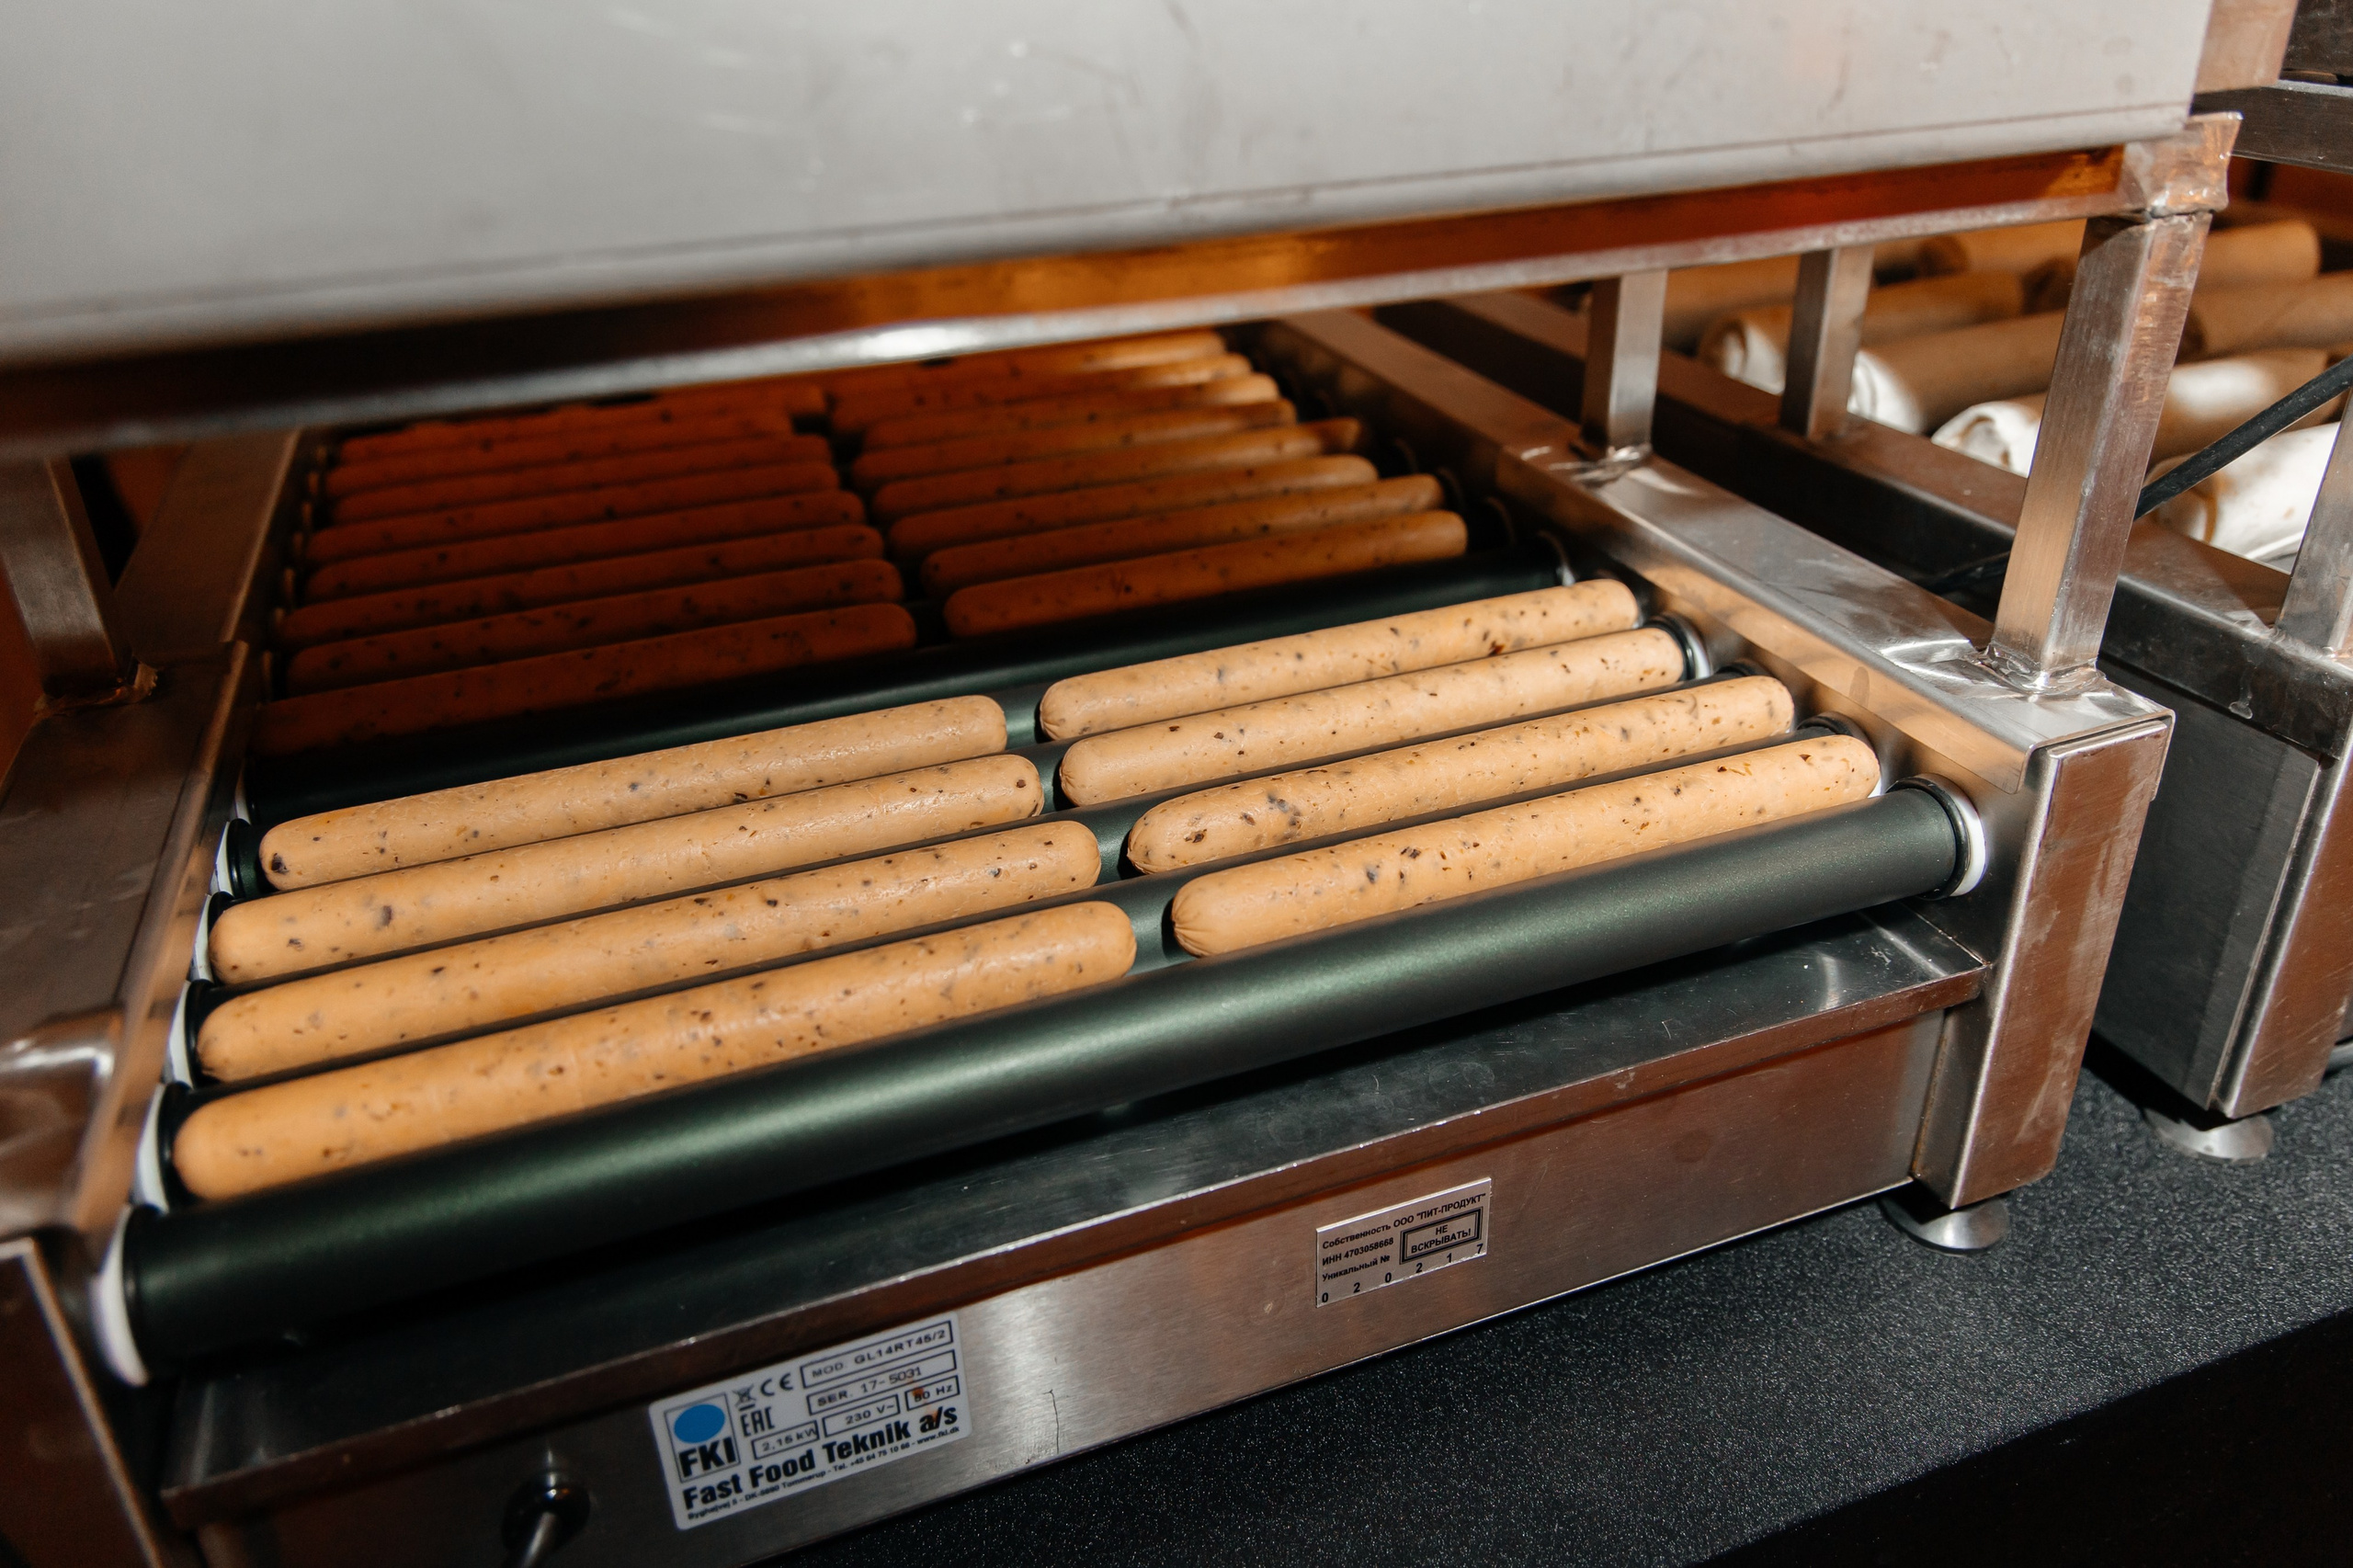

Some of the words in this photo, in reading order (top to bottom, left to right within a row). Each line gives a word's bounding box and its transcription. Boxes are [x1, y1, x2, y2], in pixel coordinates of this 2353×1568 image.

[1322, 1223, 1392, 1250] Собственность
[1393, 1214, 1415, 1228] ООО
[1416, 1193, 1486, 1220] "ПИТ-ПРОДУКТ"
[1435, 1224, 1449, 1235] НЕ
[1322, 1253, 1342, 1267] ИНН
[1344, 1237, 1394, 1258] 4703058668
[1411, 1228, 1472, 1254] ВСКРЫВАТЬ!
[1322, 1257, 1379, 1281] Уникальный
[1380, 1255, 1391, 1264] №
[936, 1383, 953, 1396] Hz
[845, 1409, 872, 1426] 230
[678, 1436, 736, 1479] FKI
[682, 1472, 744, 1510] Fast
[748, 1449, 816, 1488] Food
[822, 1420, 912, 1464] Teknik
[918, 1405, 959, 1434] a/s
[890, 1446, 899, 1454] 10
